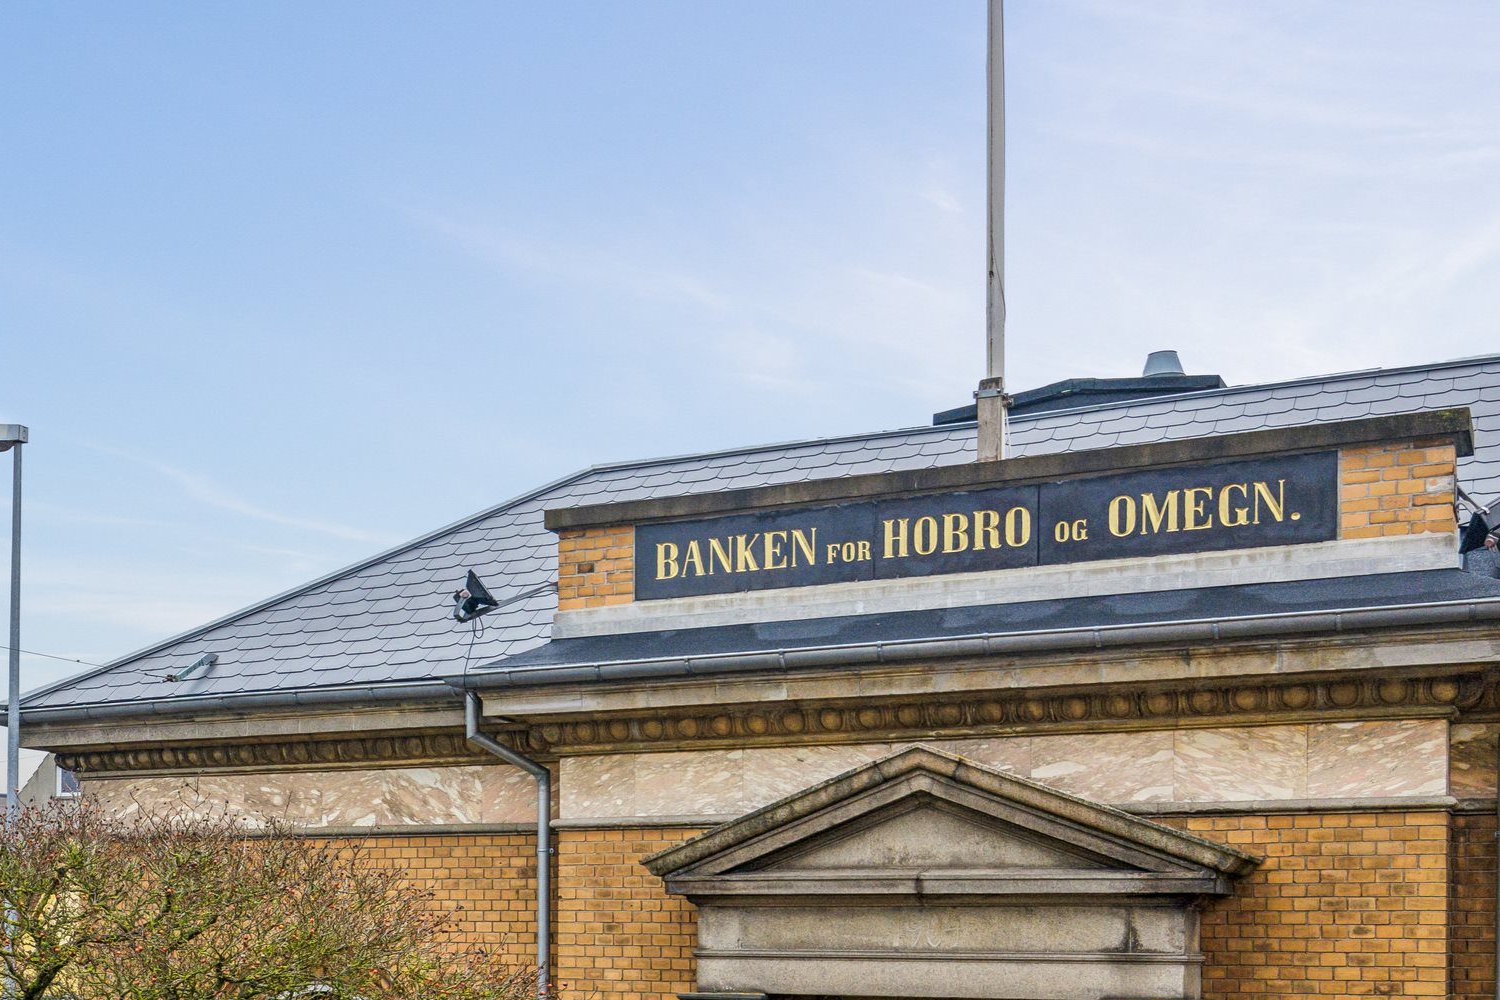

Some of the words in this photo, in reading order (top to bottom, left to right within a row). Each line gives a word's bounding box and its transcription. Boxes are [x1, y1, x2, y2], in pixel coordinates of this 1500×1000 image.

[655, 527, 817, 581] BANKEN
[826, 541, 871, 565] FOR
[882, 506, 1032, 560] HOBRO
[1054, 518, 1089, 543] OG
[1108, 479, 1302, 538] OMEGN.
